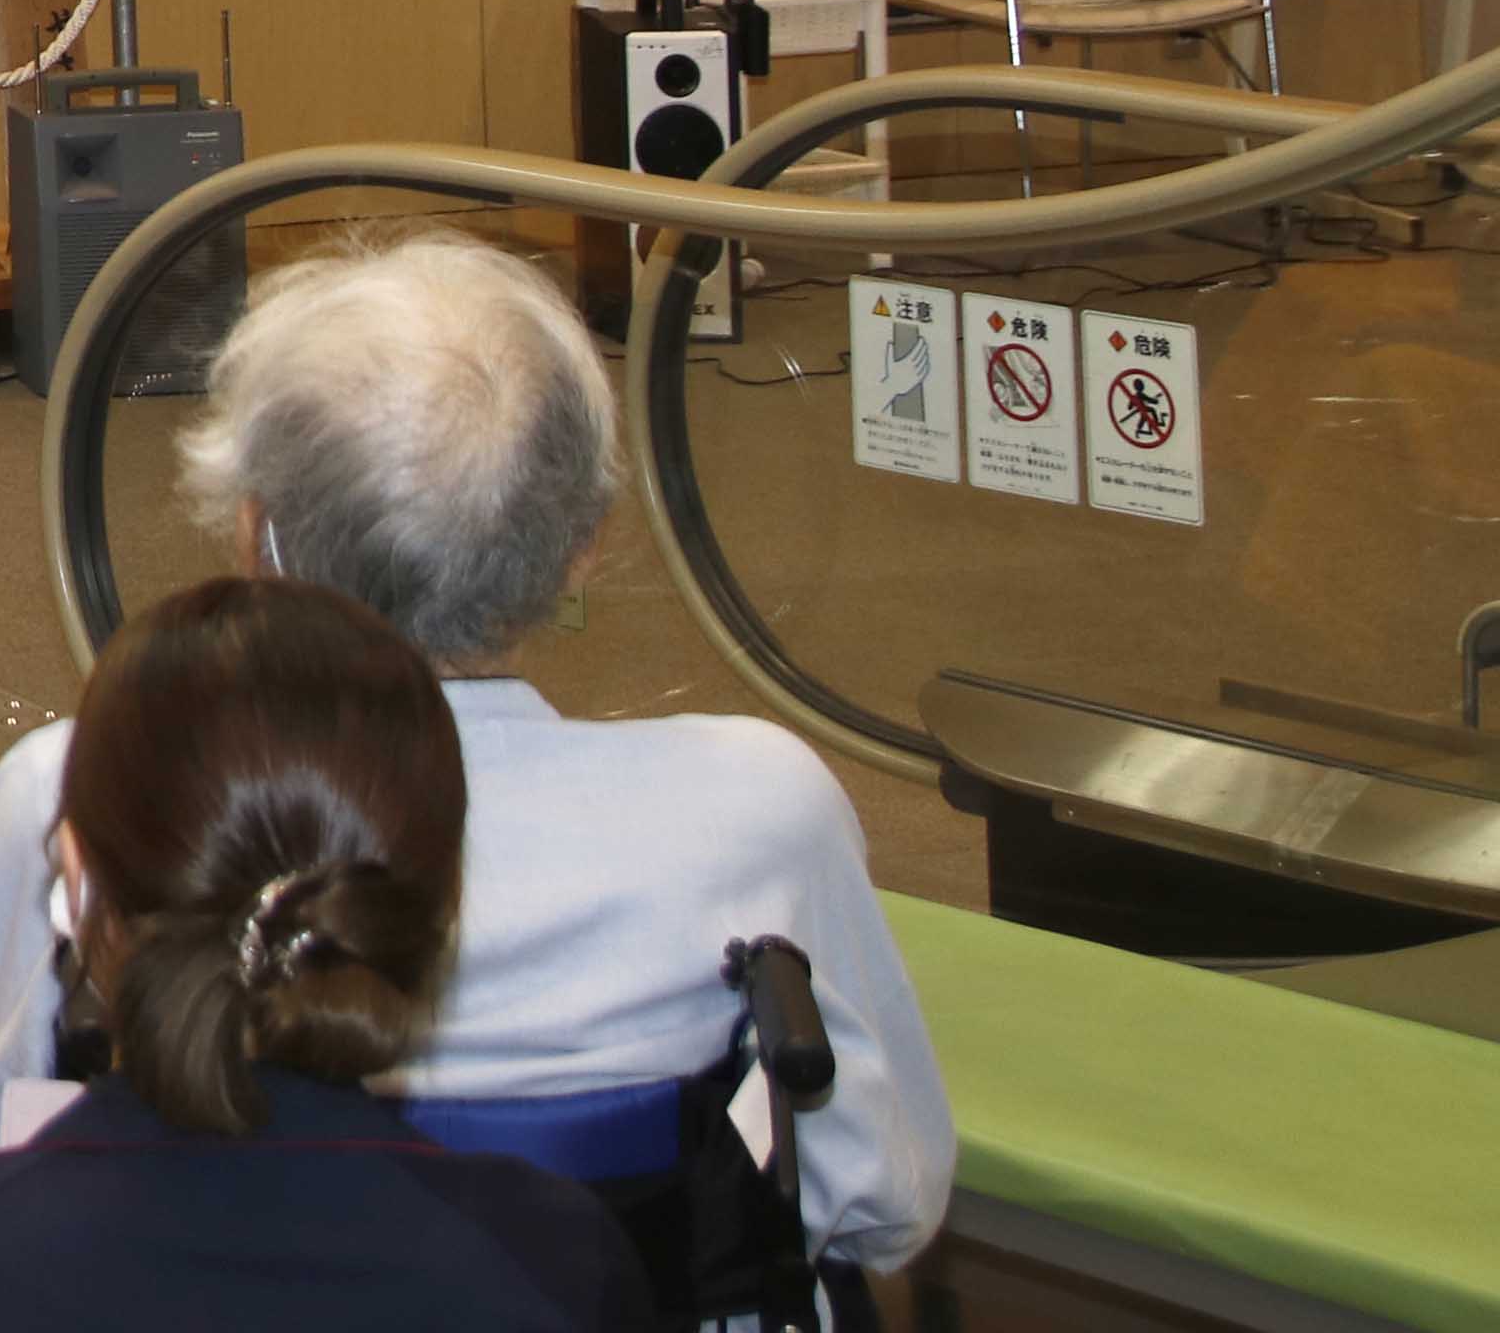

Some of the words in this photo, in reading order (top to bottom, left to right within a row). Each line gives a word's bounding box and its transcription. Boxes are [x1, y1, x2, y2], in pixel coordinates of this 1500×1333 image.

[896, 298, 934, 324] 注意
[1011, 317, 1049, 342] 危険
[1134, 334, 1172, 360] 危険
